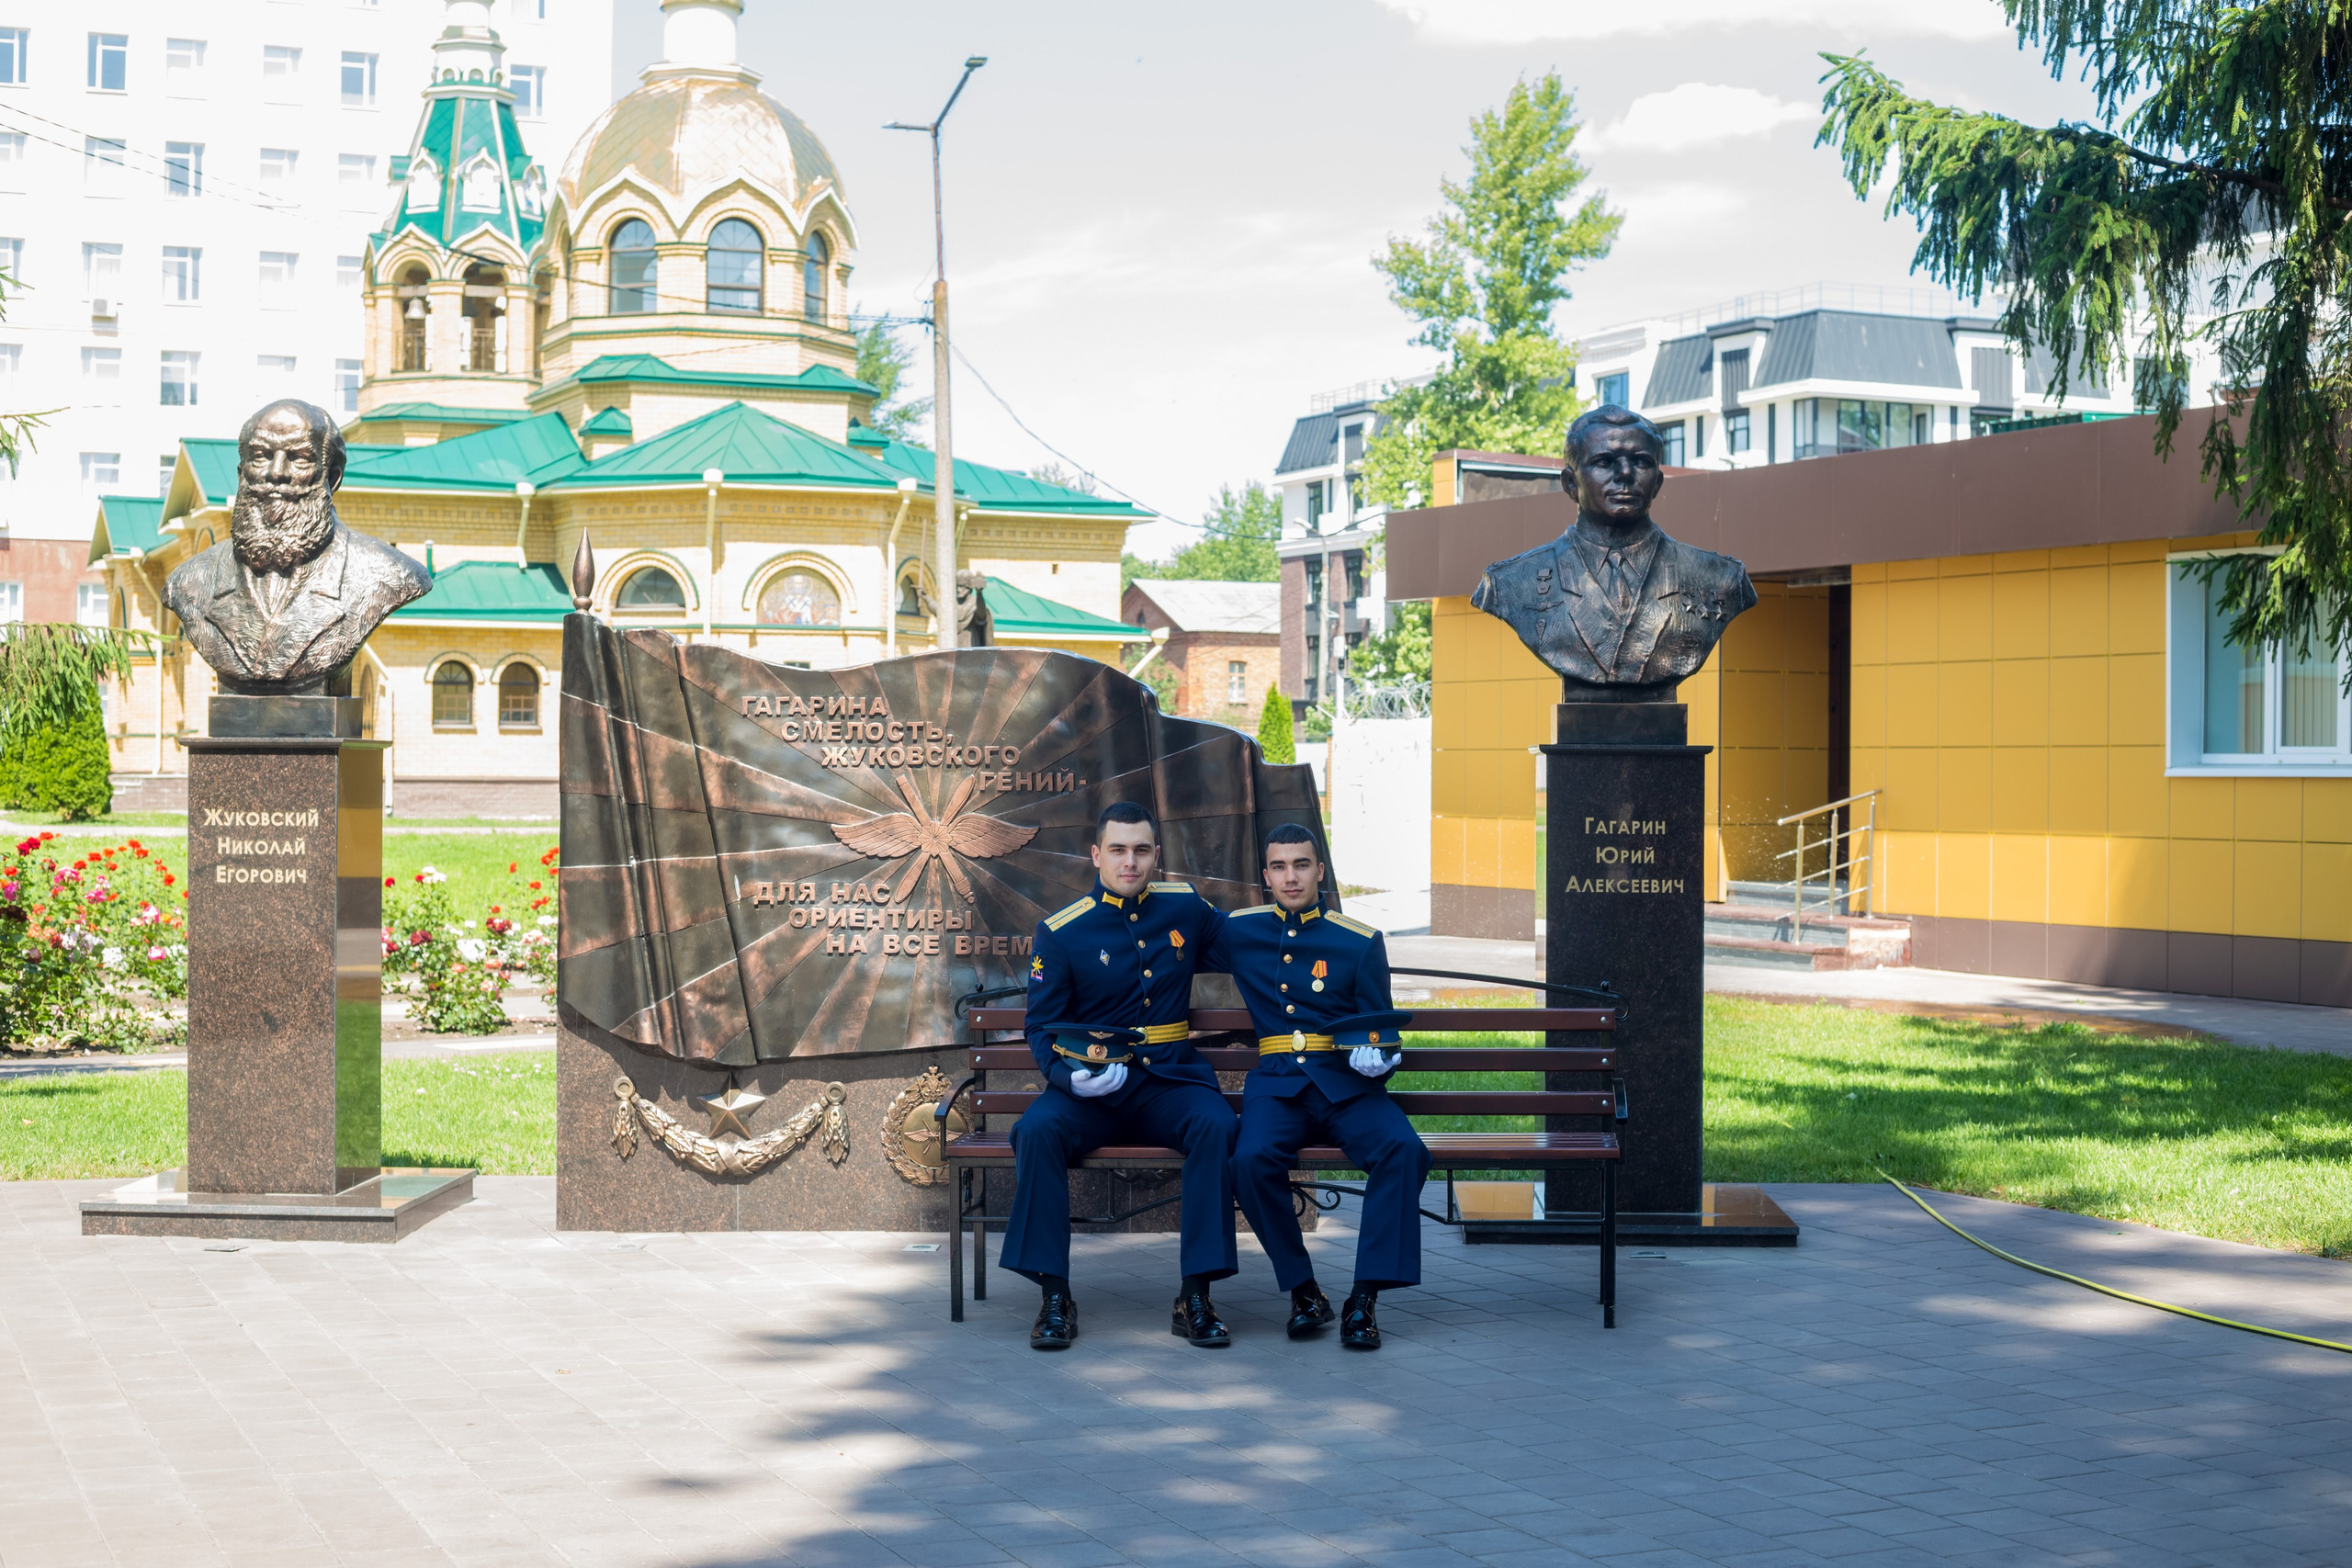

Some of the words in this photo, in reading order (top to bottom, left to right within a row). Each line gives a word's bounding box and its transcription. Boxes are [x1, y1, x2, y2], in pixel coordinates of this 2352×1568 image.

[741, 695, 888, 717] ГАГАРИНА
[781, 721, 954, 746] СМЕЛОСТЬ,
[820, 745, 1020, 768] ЖУКОВСКОГО
[753, 882, 816, 907] ДЛЯ
[831, 883, 890, 904] НАС
[788, 908, 973, 931] ОРИЕНТИРЫ
[826, 934, 867, 955] НА
[883, 934, 940, 955] ВСЕ
